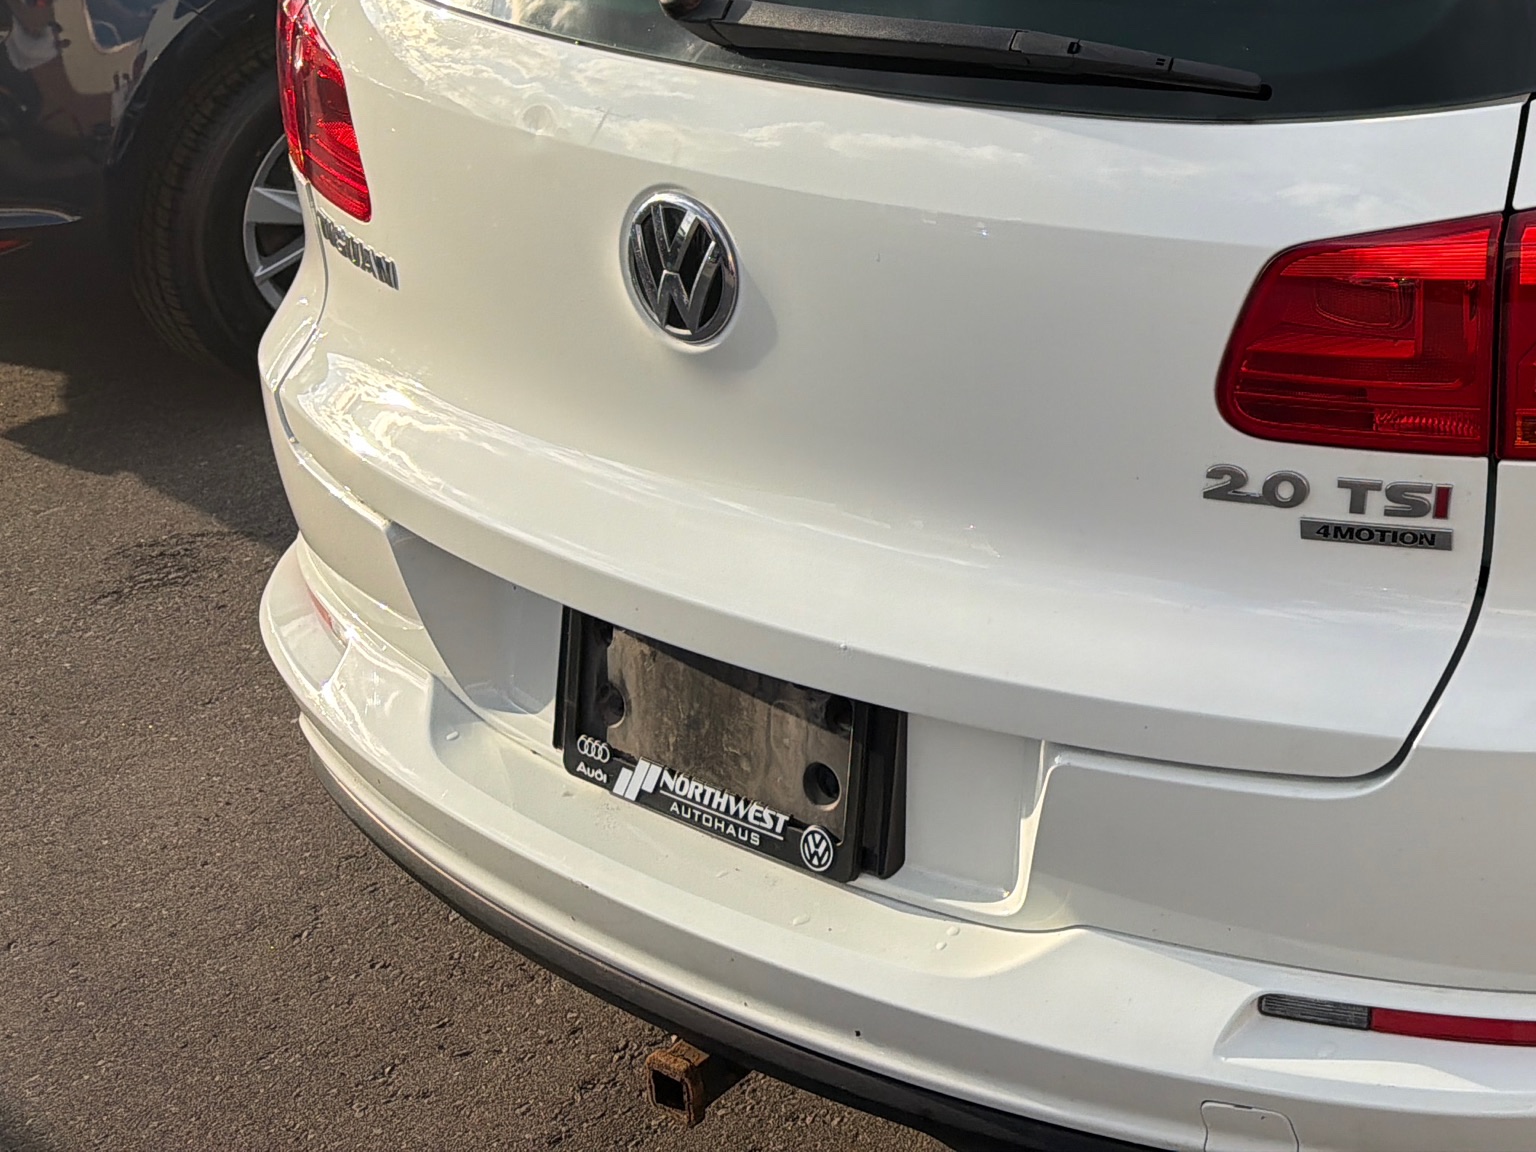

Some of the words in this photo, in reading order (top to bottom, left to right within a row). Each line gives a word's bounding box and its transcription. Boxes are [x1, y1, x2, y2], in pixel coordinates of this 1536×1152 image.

[1203, 464, 1310, 508] 2.0
[1337, 477, 1454, 520] TSI
[1316, 525, 1436, 546] 4MOTION
[576, 761, 607, 784] Audi
[659, 767, 790, 834] NORTHWEST
[669, 801, 761, 846] AUTOHAUS
